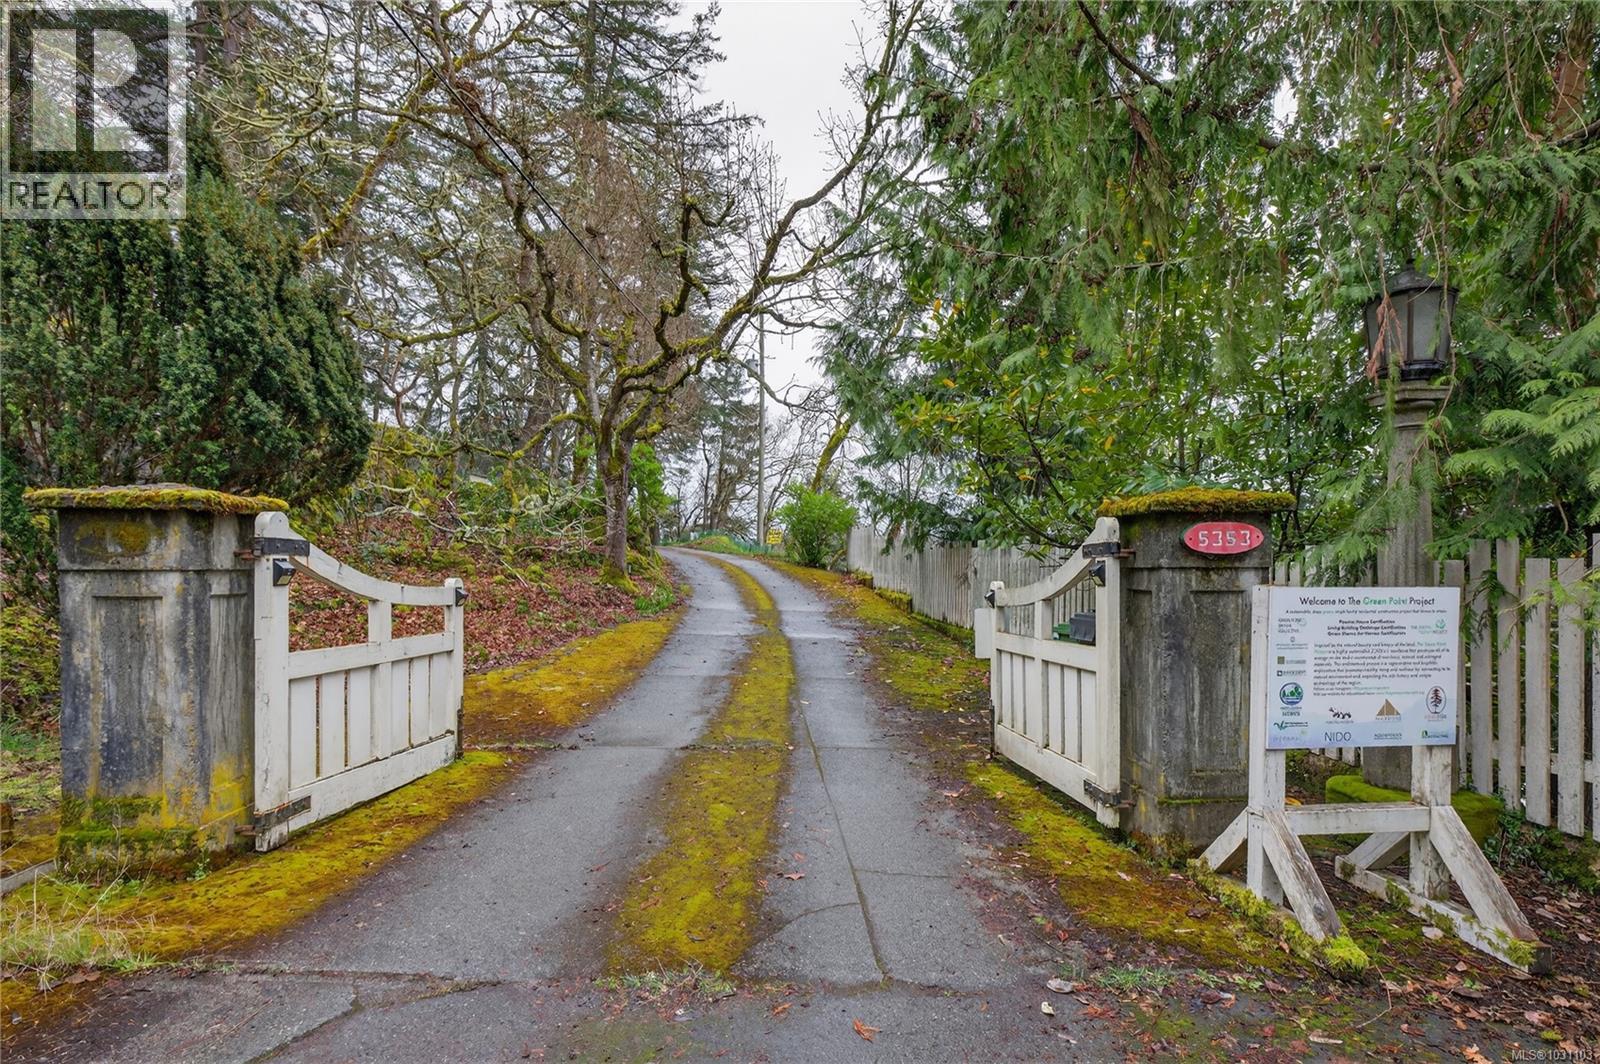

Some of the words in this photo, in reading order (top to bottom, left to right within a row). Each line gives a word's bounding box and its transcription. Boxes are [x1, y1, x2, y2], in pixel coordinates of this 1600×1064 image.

[1198, 530, 1251, 547] 5353
[1299, 596, 1336, 606] Welcome
[1338, 597, 1346, 606] to
[1348, 596, 1361, 606] The
[1363, 596, 1387, 606] Green
[1389, 596, 1408, 606] Point
[1409, 596, 1435, 607] Project
[1324, 731, 1352, 742] NIDO
